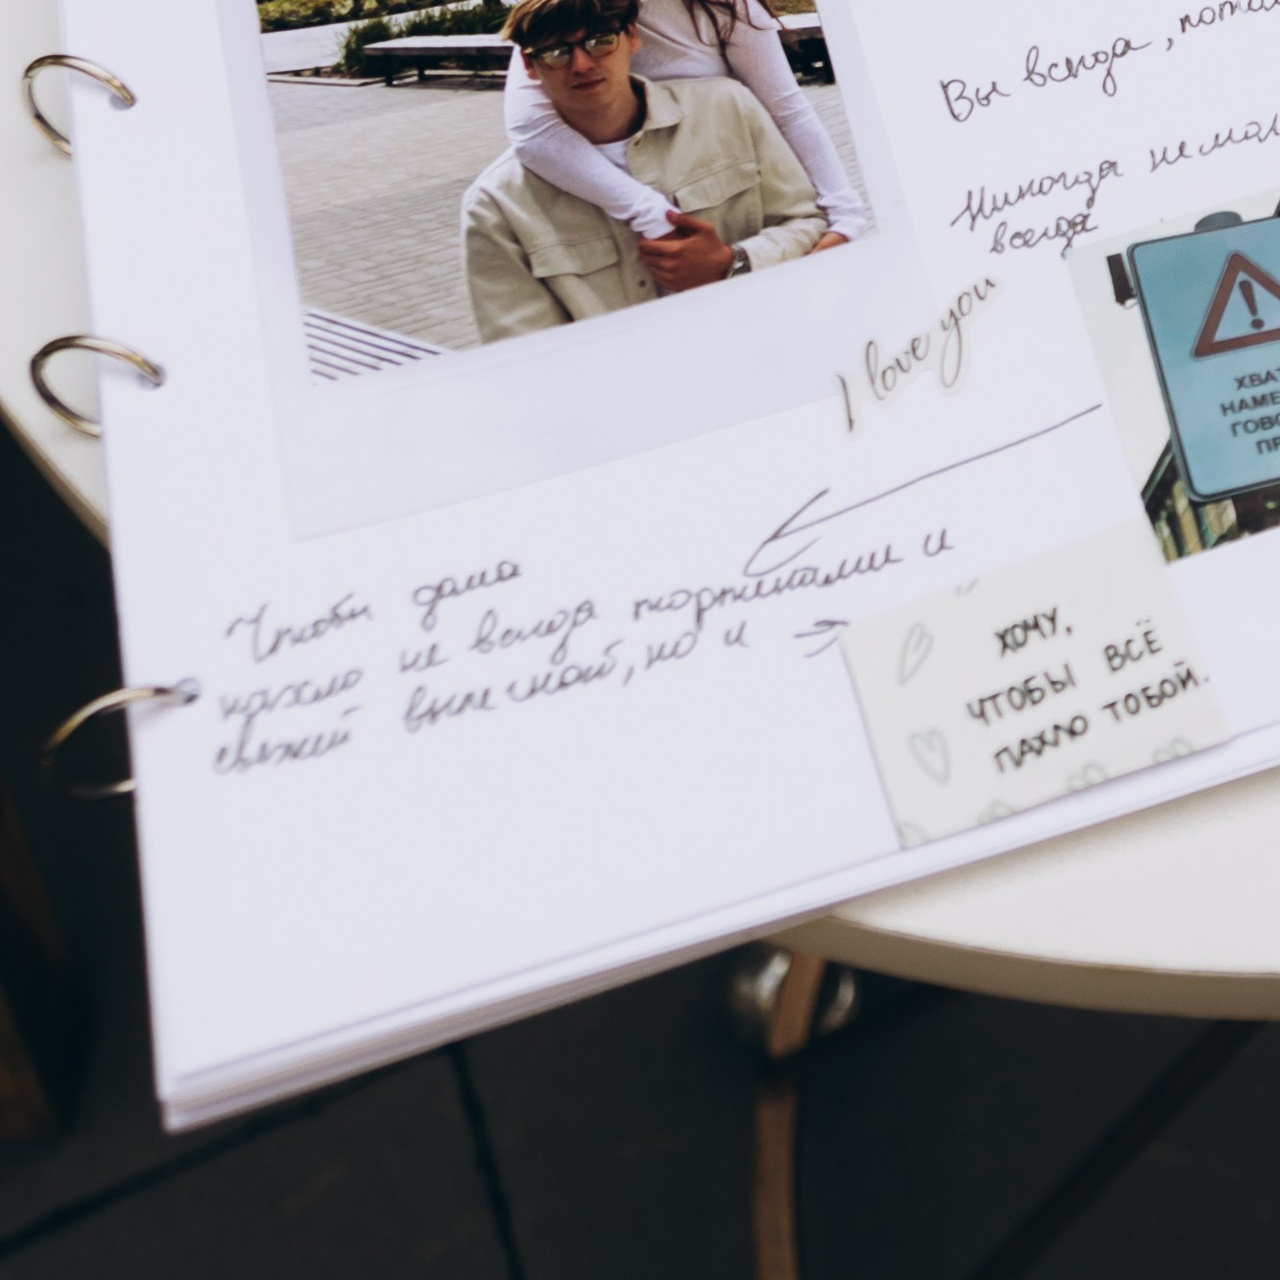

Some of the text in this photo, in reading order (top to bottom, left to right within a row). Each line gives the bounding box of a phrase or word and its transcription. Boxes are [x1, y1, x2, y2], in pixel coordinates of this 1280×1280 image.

[940, 79, 1010, 122] Вы
[864, 330, 930, 401] love
[940, 275, 998, 390] you
[399, 642, 446, 673] не
[922, 528, 954, 557] и
[967, 617, 1163, 727] ЧТОБЫ ВСЁ
[993, 715, 1089, 775] ПАХЛО
